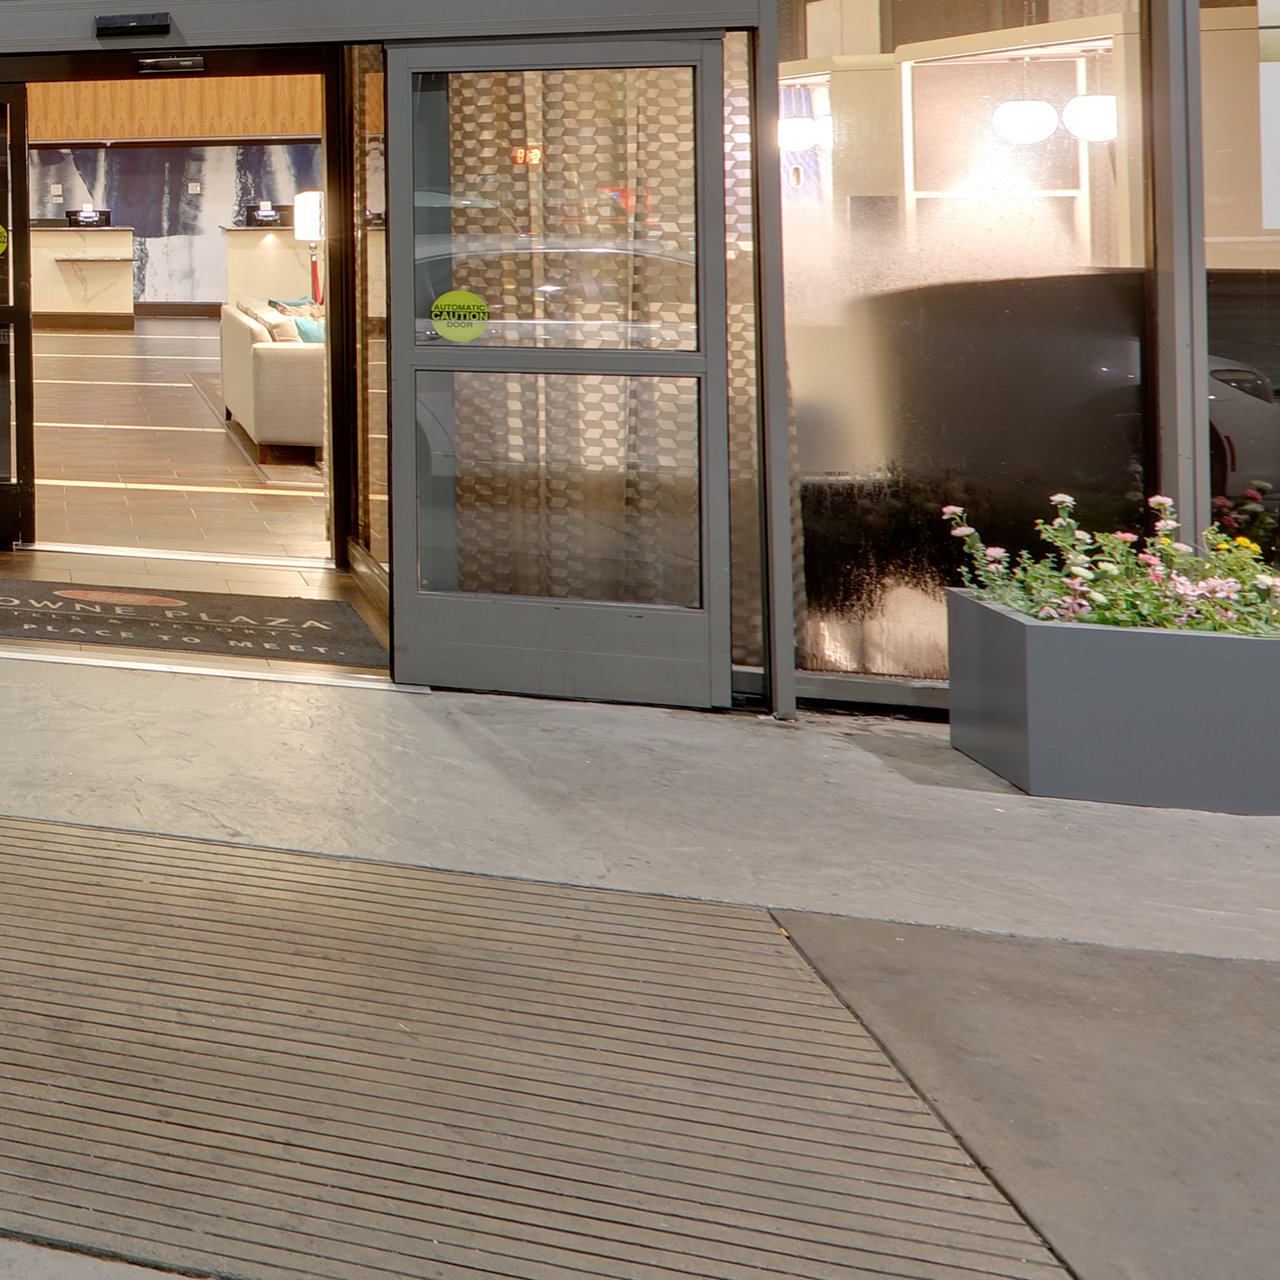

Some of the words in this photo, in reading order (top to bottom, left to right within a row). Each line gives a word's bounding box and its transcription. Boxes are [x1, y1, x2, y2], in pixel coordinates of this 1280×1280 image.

[431, 311, 488, 320] CAUTION
[165, 610, 332, 630] PLAZA
[23, 623, 135, 639] PLACE
[157, 634, 201, 644] TO
[228, 639, 345, 656] MEET.
[150, 622, 303, 639] RESORTS
